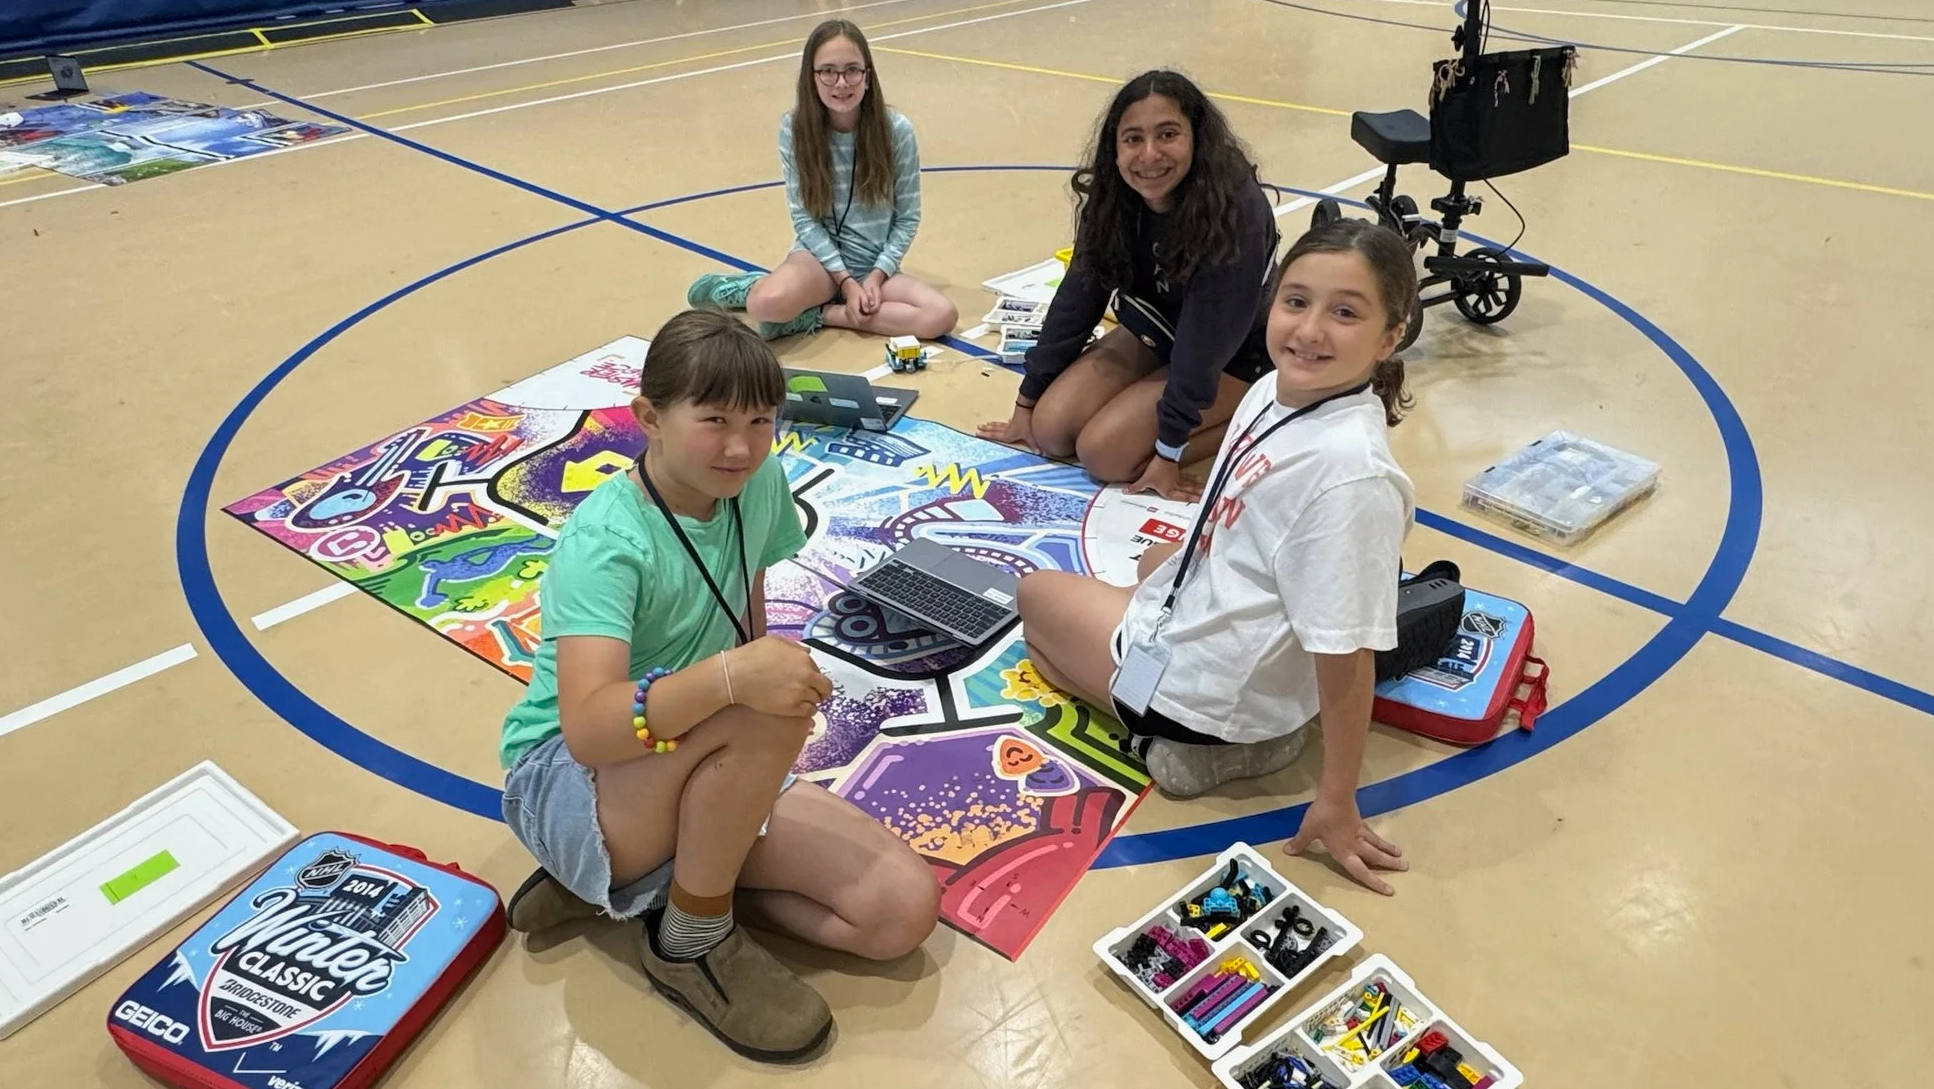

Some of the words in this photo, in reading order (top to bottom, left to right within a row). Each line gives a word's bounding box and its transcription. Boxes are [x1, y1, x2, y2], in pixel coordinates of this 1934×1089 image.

[305, 863, 344, 878] NHL
[342, 879, 385, 898] 2014
[212, 888, 393, 994] Winter
[238, 951, 336, 1002] CLASSIC
[218, 978, 302, 1019] BRIDGESTONE
[114, 1000, 190, 1044] GEICO
[214, 1009, 232, 1021] BIG
[267, 1075, 305, 1089] veri
